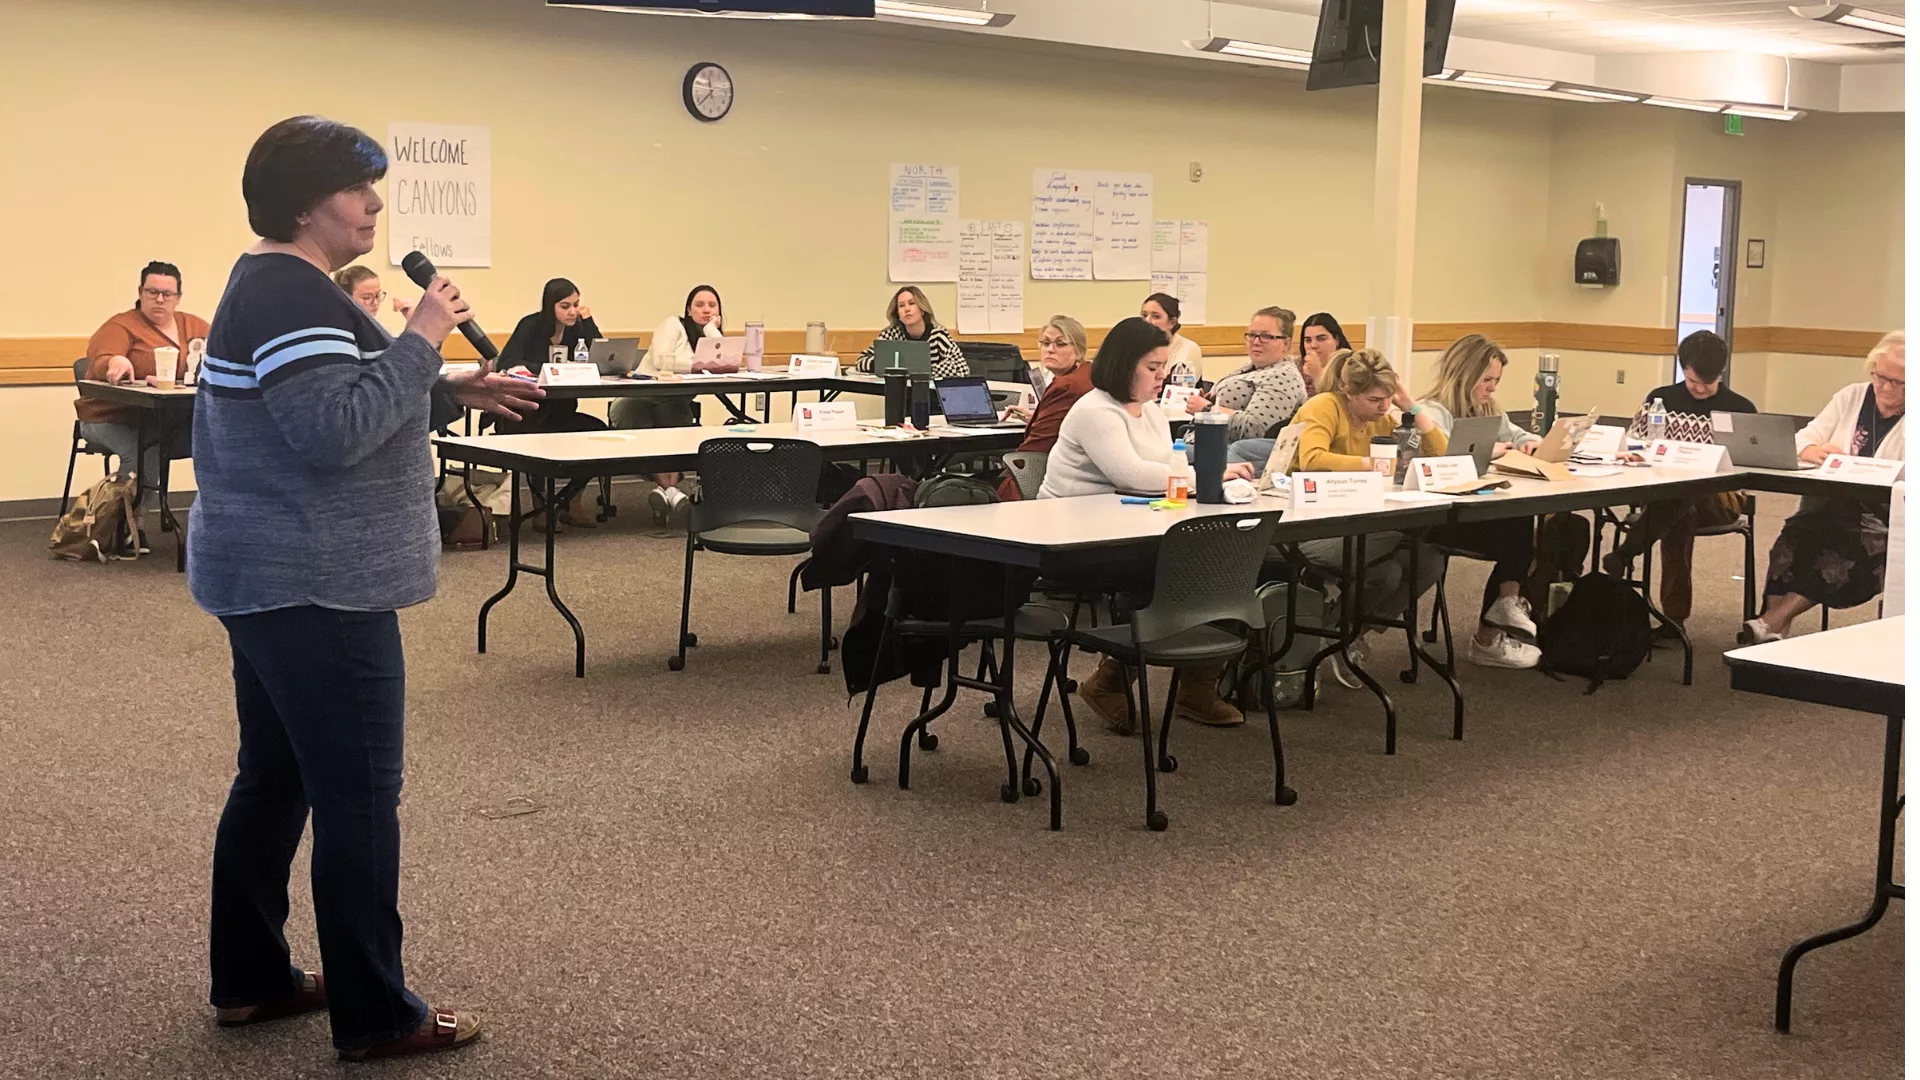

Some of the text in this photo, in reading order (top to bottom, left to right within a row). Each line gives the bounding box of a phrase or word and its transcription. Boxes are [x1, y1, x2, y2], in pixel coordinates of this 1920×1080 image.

[394, 135, 469, 166] WELCOME
[904, 164, 943, 176] NORTH
[397, 178, 477, 216] CANYONS
[980, 220, 1002, 232] EAST
[412, 236, 453, 258] Fellows
